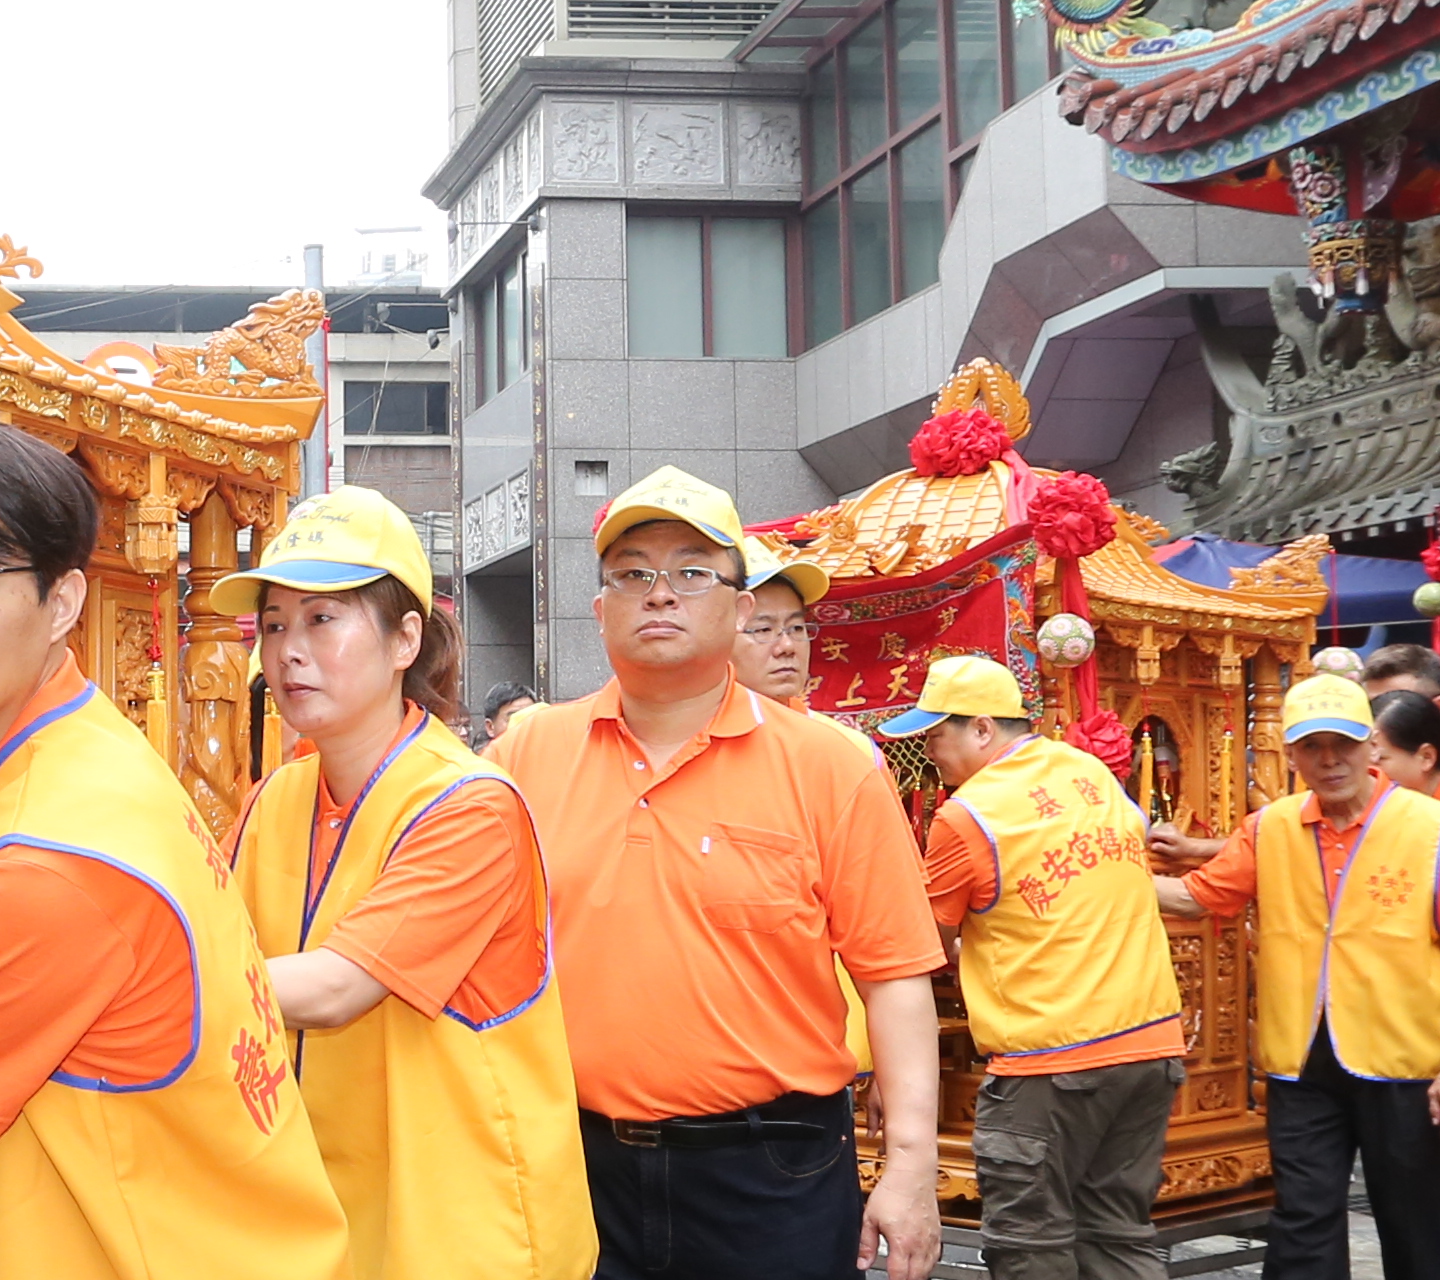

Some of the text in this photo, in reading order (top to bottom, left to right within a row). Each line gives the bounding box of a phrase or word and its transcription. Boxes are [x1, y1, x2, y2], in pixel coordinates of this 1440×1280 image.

[1027, 776, 1106, 820] 基隆
[1016, 825, 1154, 920] 慶安宮媽祖
